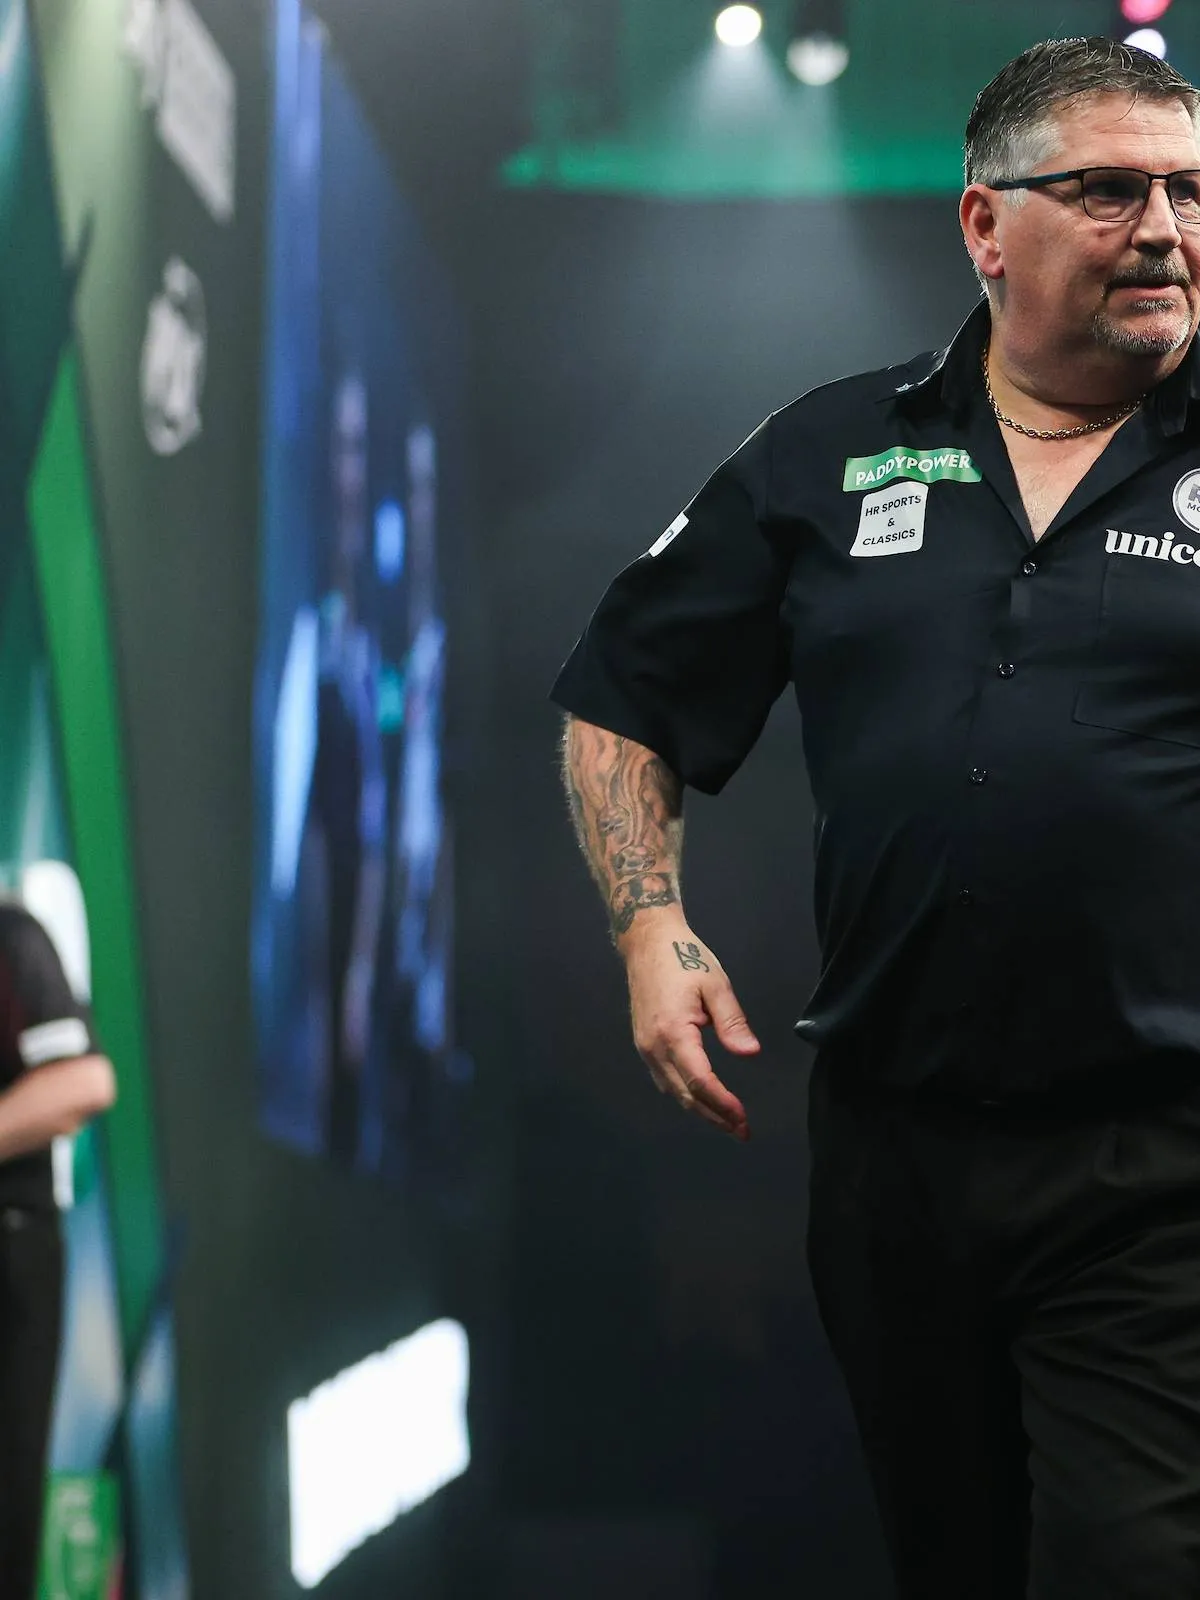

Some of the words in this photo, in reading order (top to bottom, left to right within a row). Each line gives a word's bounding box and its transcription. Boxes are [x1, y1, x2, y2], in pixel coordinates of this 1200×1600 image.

[865, 506, 879, 517] HR
[882, 495, 922, 513] SPORTS
[887, 518, 895, 527] &
[862, 528, 916, 546] CLASSICS
